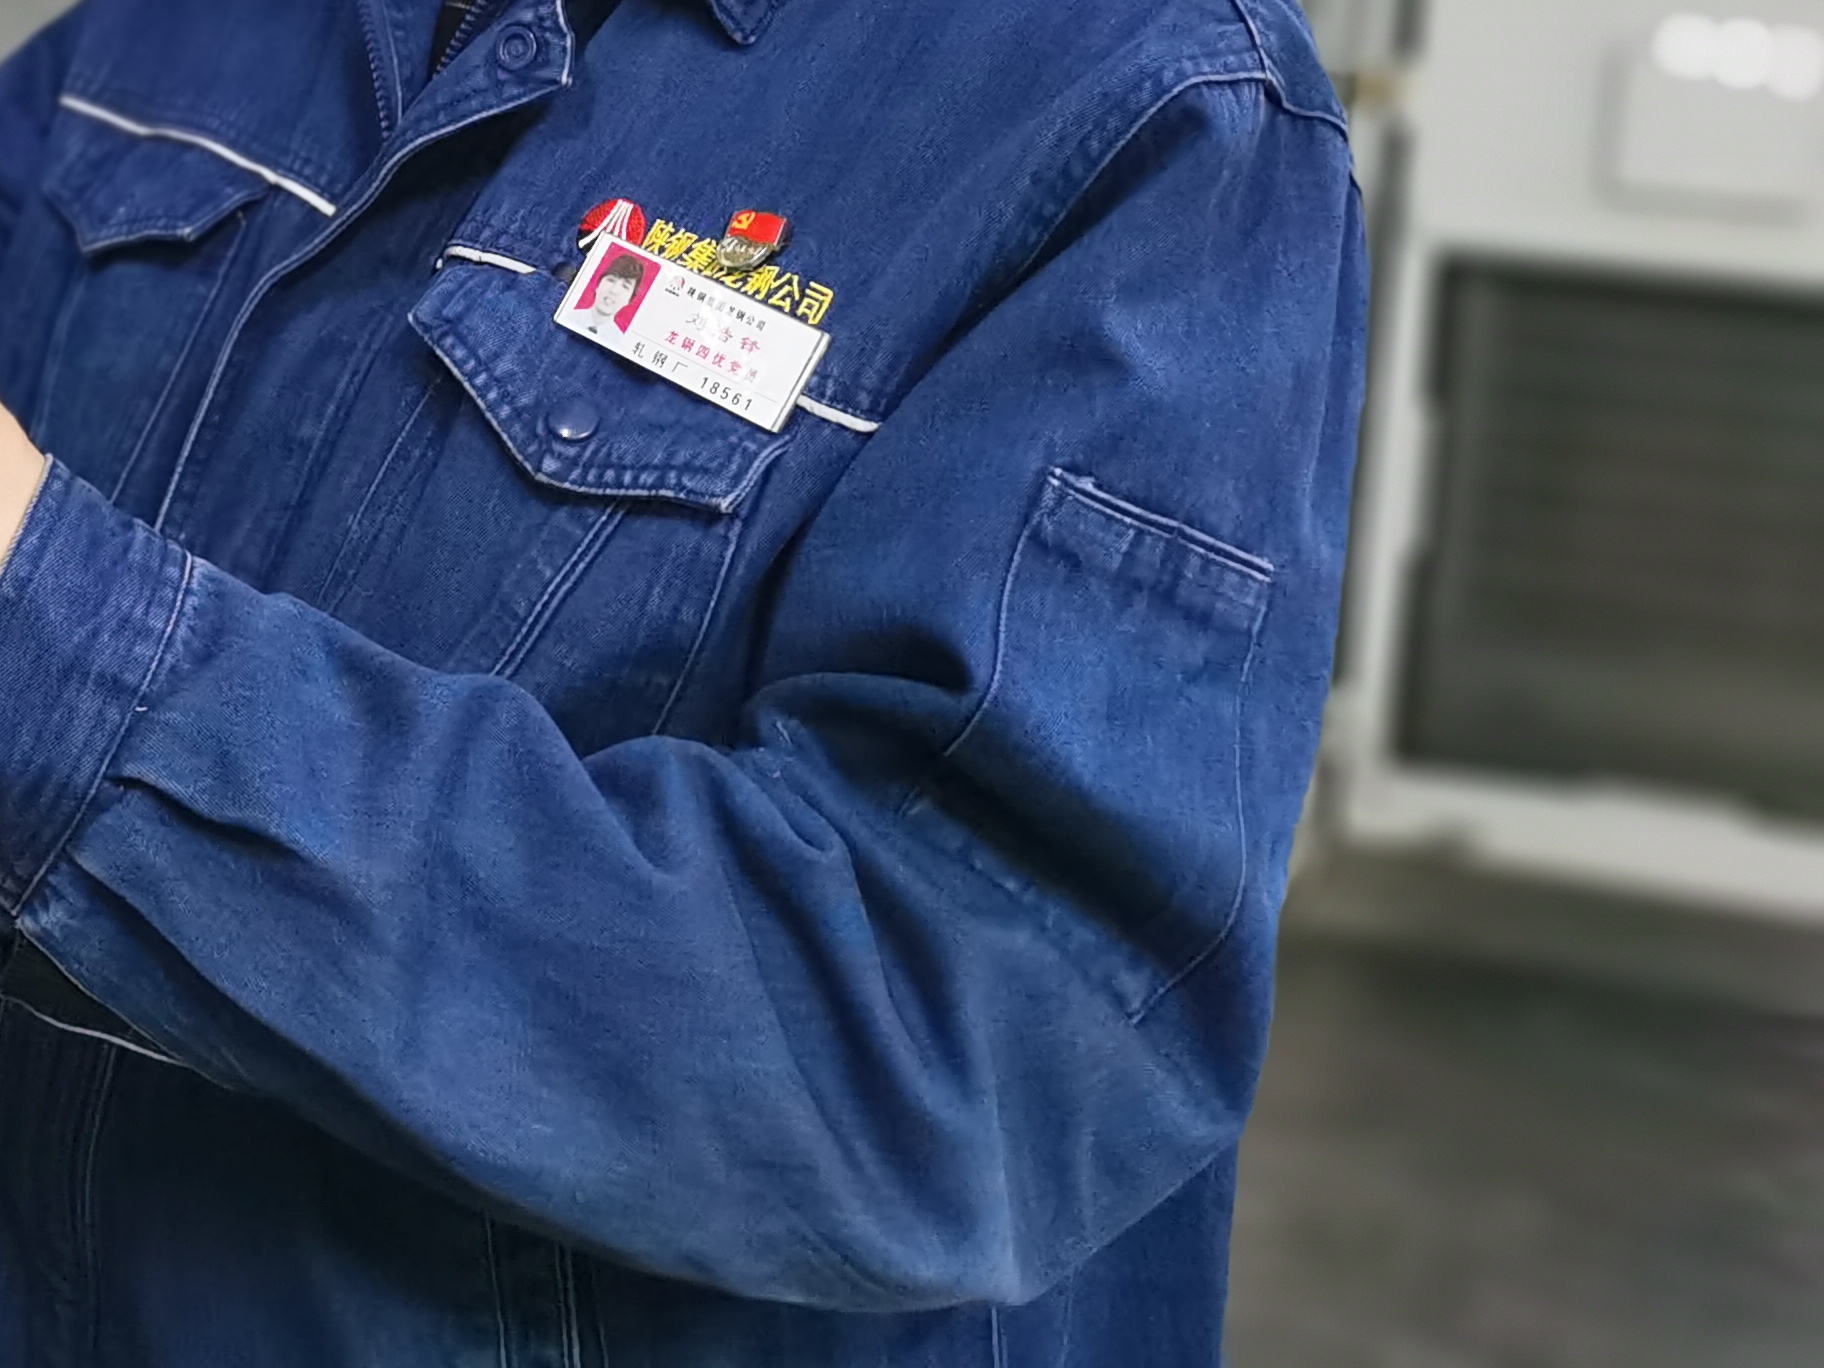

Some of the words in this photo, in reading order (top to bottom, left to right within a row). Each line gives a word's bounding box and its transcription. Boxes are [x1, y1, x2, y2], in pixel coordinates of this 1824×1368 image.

[632, 341, 689, 373] 轧钢厂
[701, 376, 753, 411] 18561
